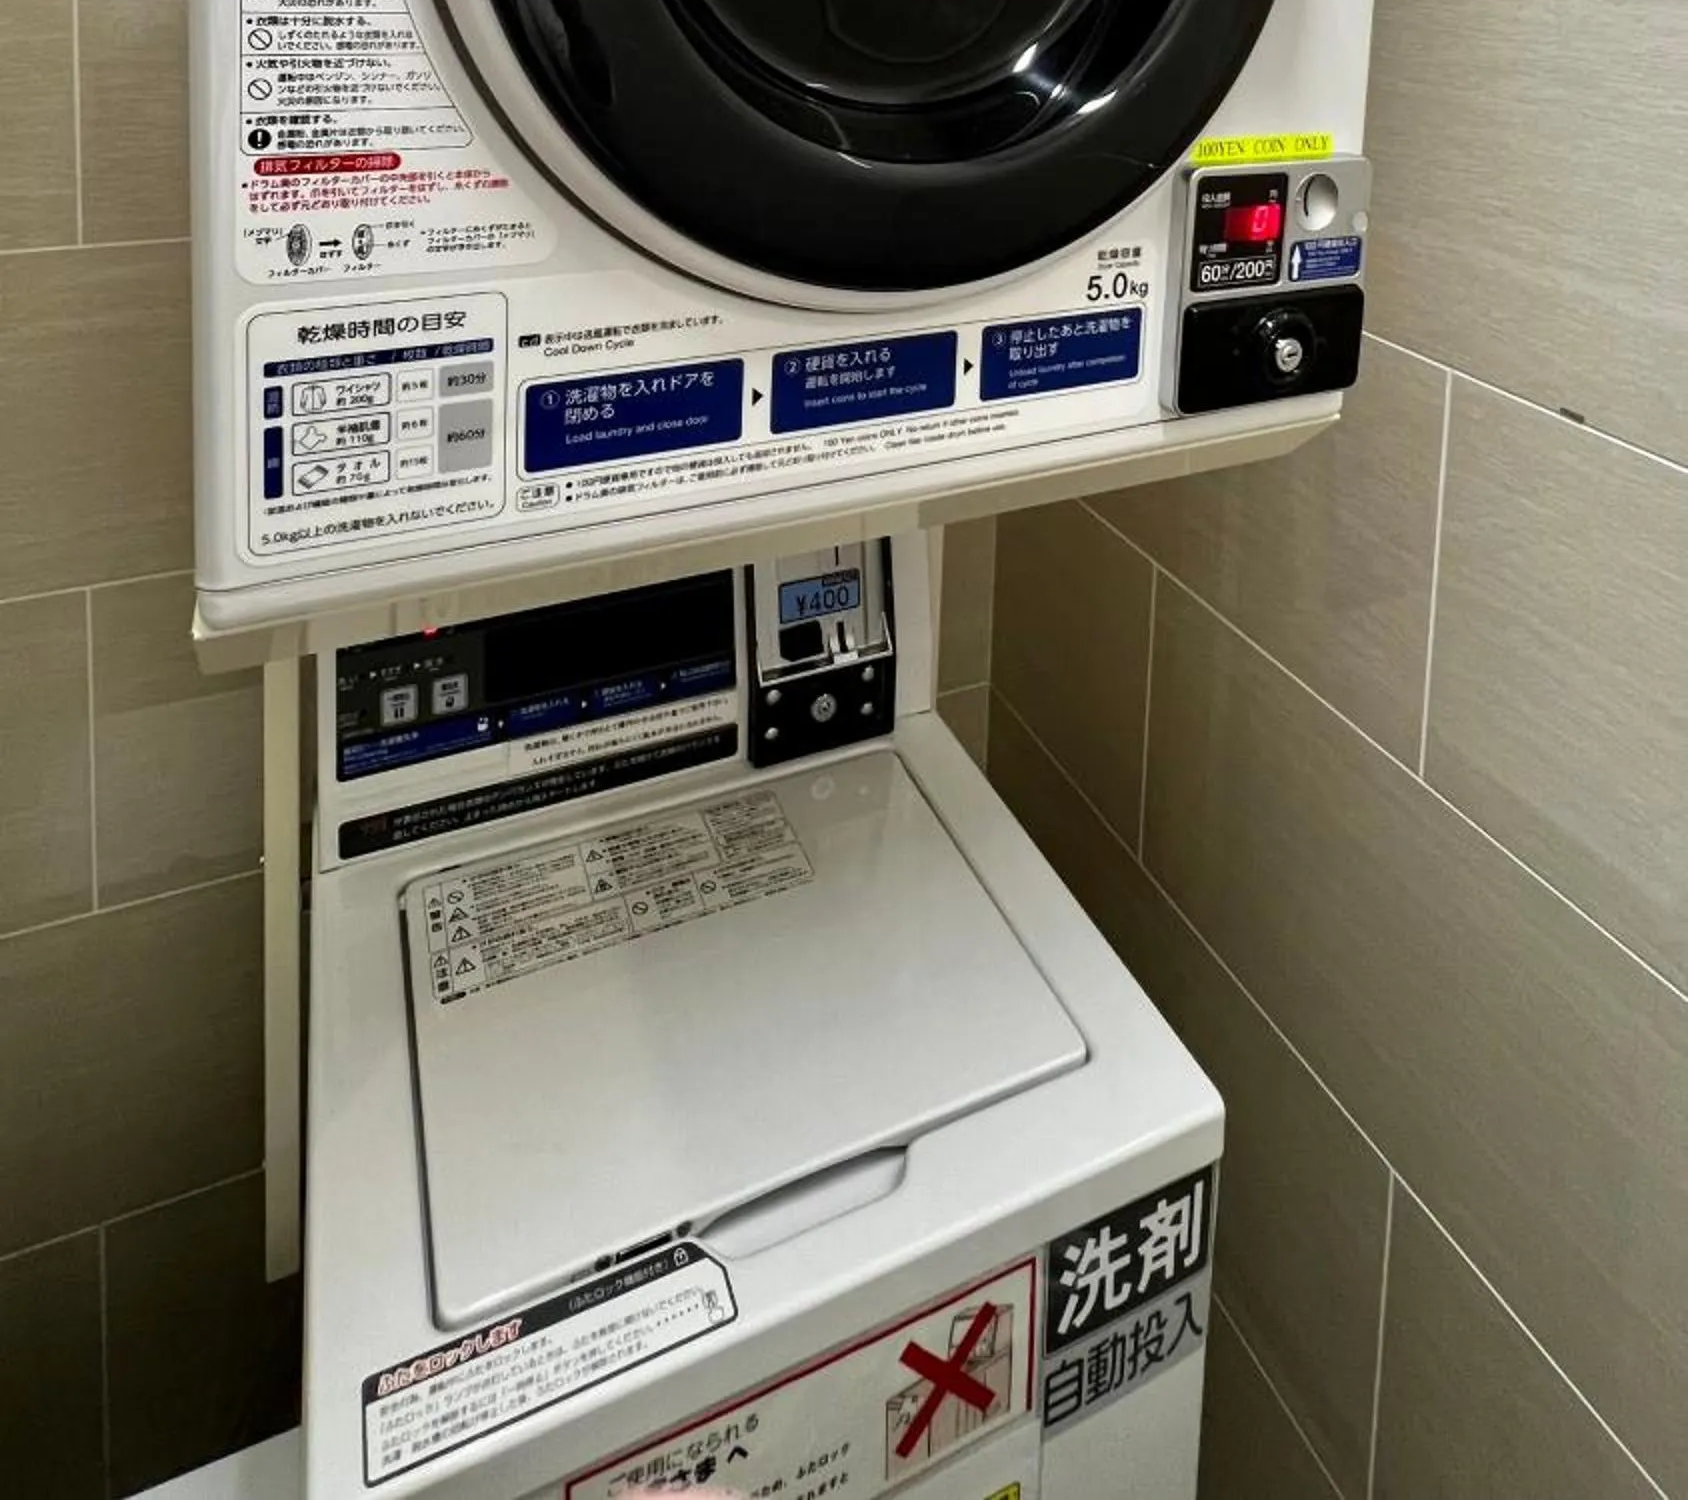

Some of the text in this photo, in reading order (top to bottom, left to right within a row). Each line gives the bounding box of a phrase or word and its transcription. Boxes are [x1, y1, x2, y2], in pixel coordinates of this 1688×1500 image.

[297, 311, 467, 344] 乾燥時間の目安
[543, 345, 569, 357] Cool
[571, 342, 602, 354] Down
[565, 430, 594, 445] Load
[1057, 1179, 1205, 1336] 洗剤
[1042, 1292, 1203, 1429] 自動投入
